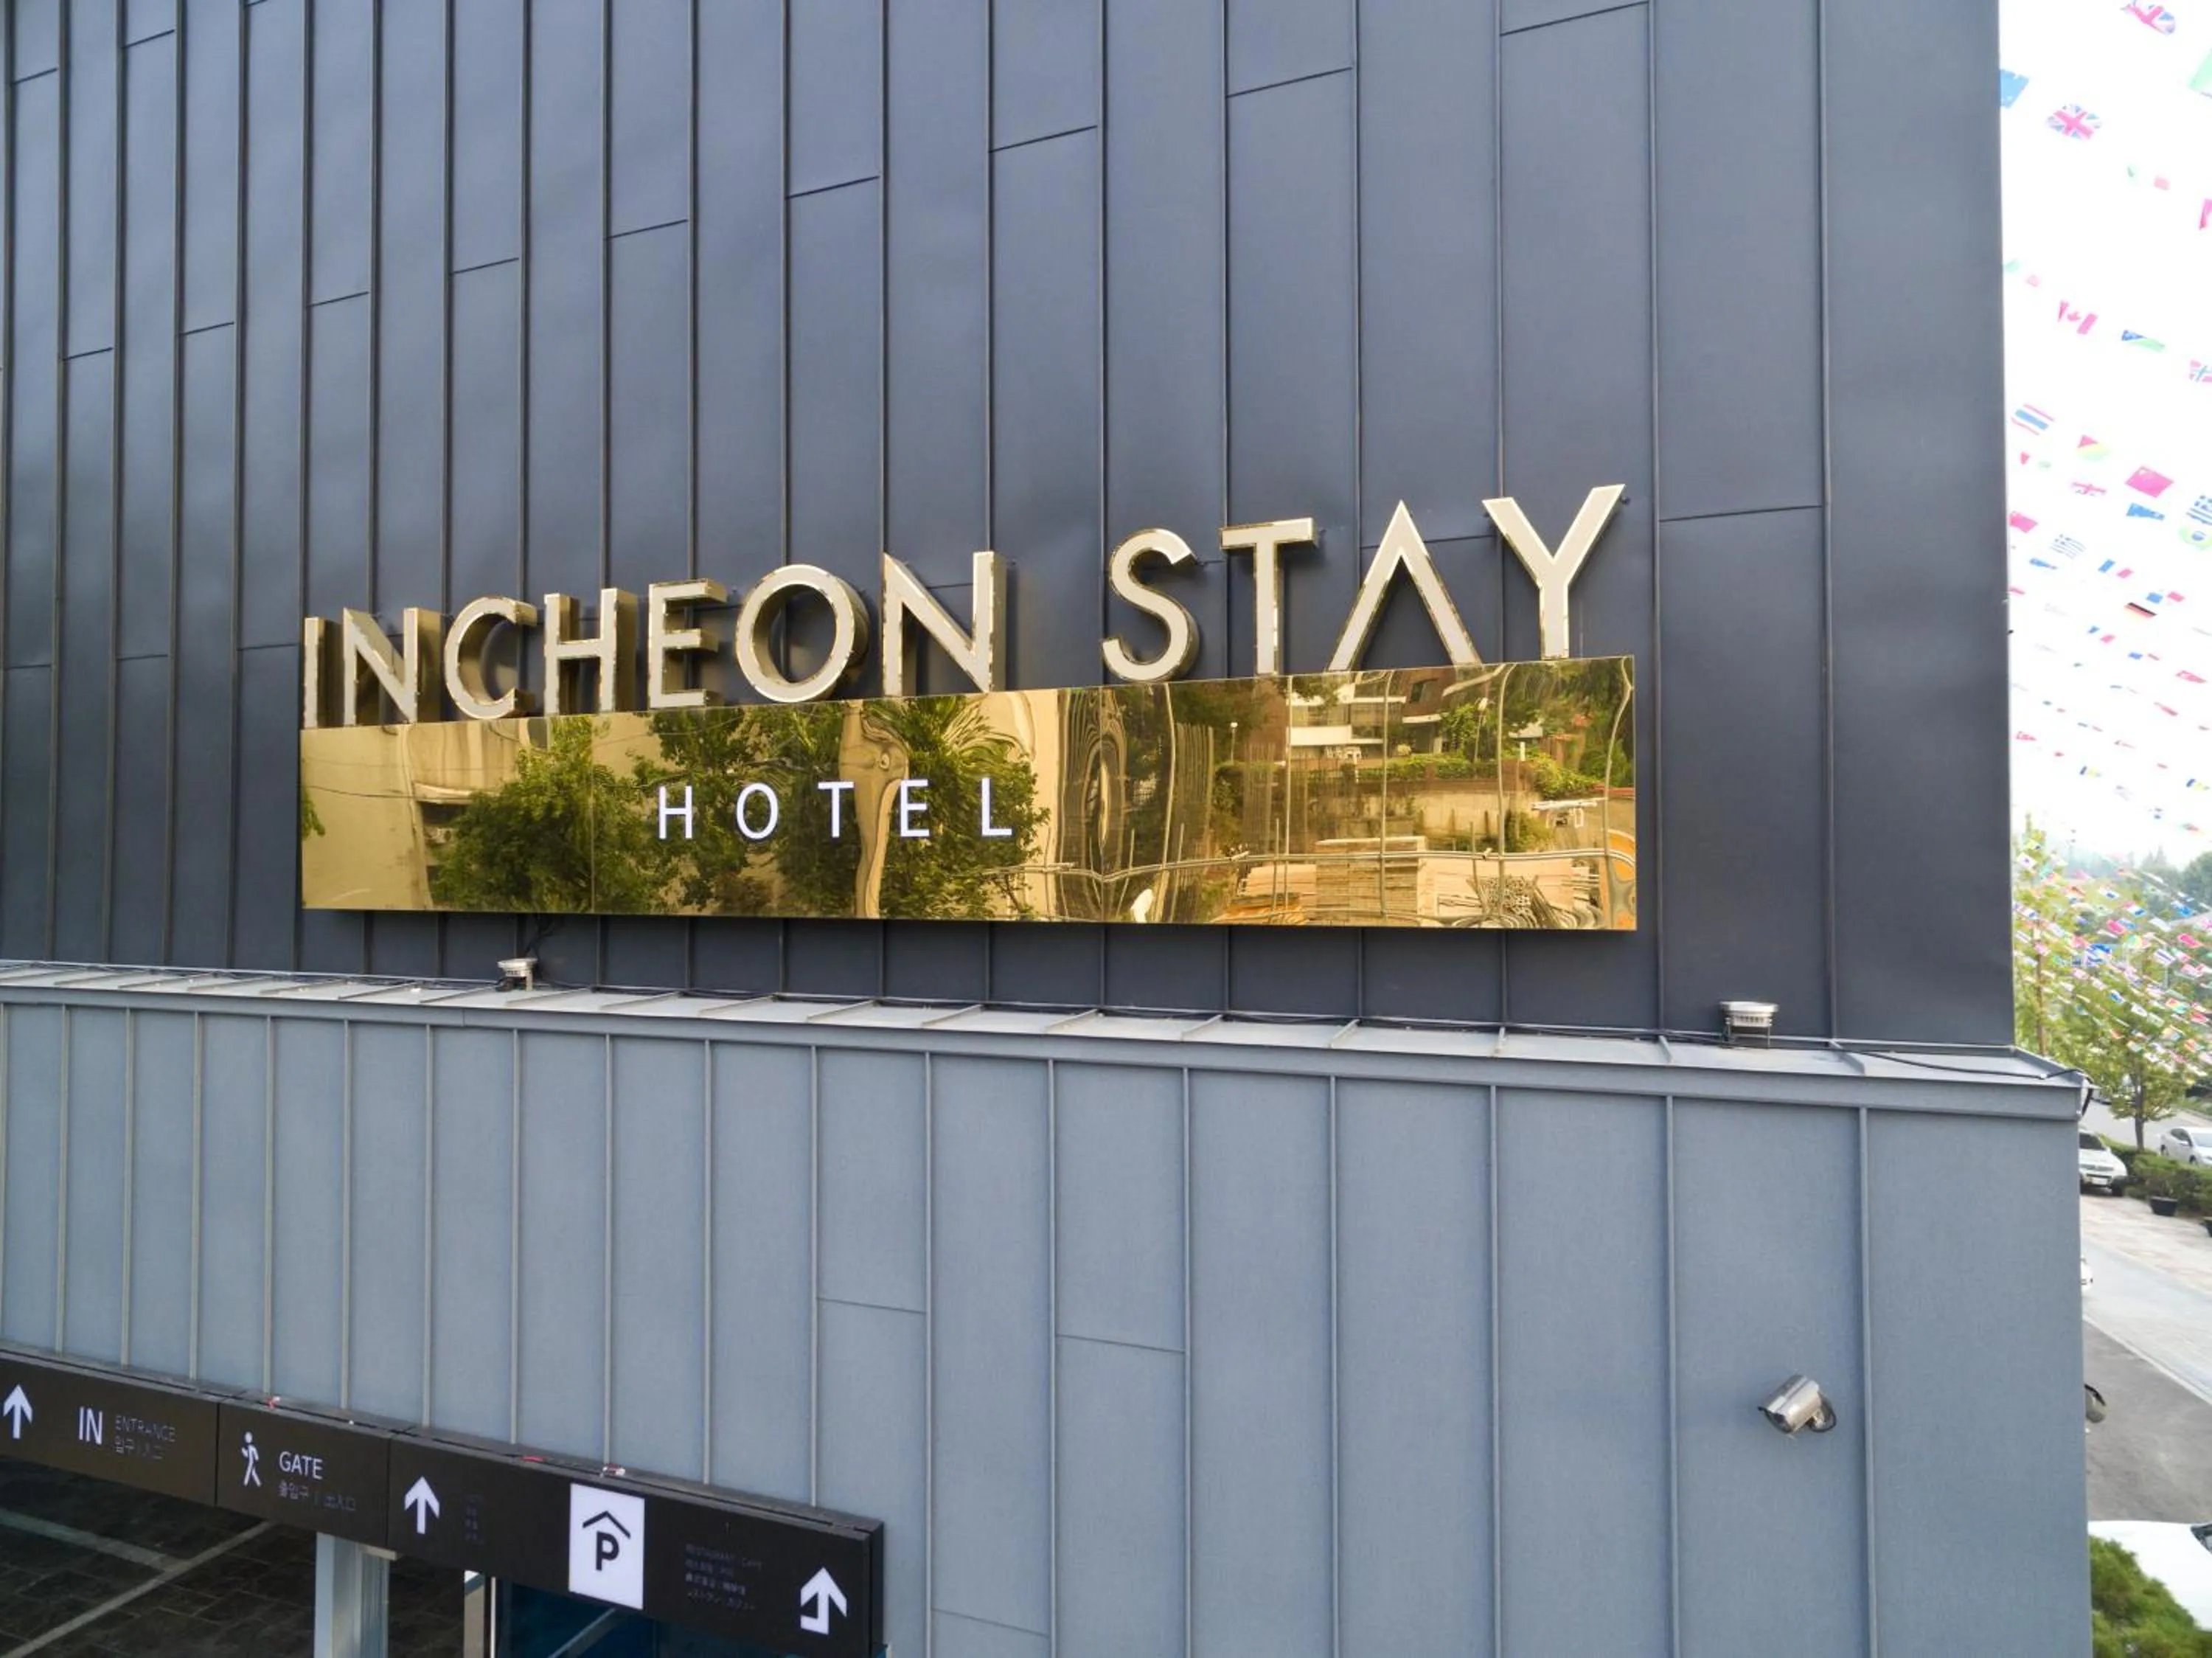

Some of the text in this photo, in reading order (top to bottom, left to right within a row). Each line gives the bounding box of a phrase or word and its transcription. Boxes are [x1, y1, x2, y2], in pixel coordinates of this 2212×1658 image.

[303, 484, 1627, 727] INCHEON STAY
[657, 777, 1013, 839] HOTEL
[78, 1406, 103, 1446] IN
[115, 1415, 176, 1442] ENTRANCE
[279, 1451, 323, 1480] GATE
[596, 1532, 620, 1571] P
